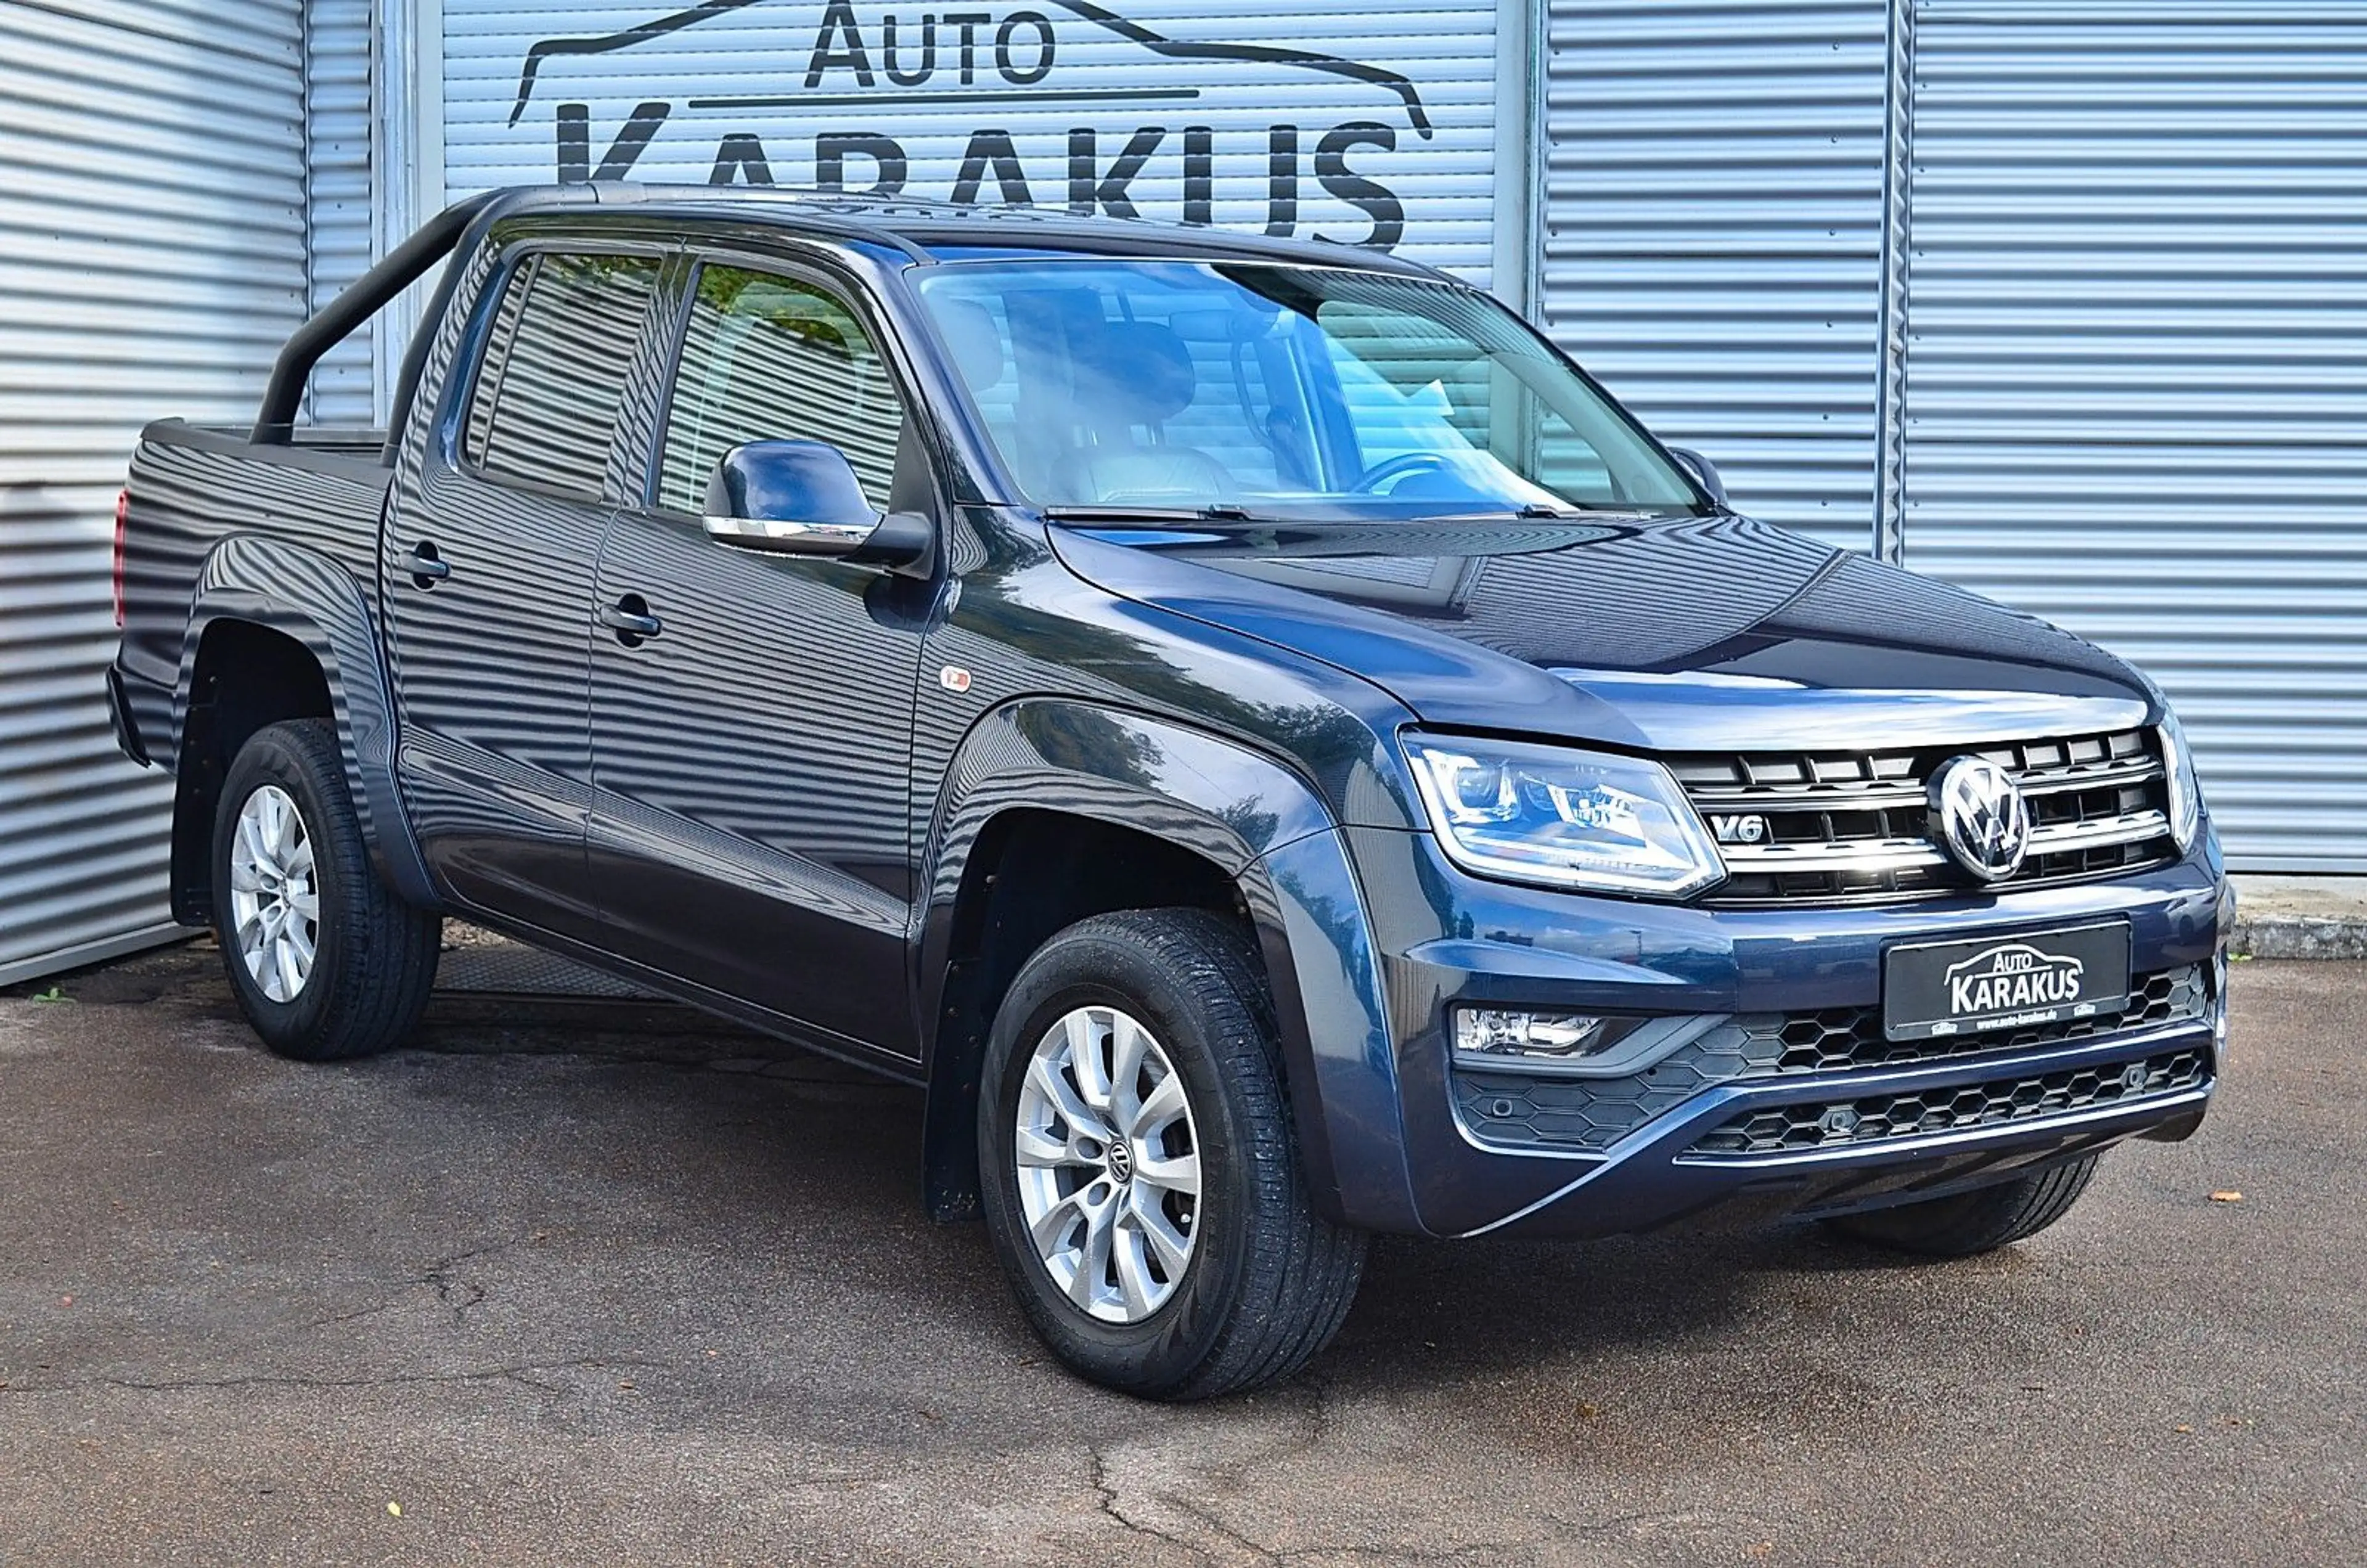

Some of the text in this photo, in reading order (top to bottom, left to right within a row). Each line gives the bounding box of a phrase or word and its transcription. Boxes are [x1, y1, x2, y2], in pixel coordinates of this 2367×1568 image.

[804, 0, 1056, 88] AUTO
[1710, 815, 1763, 843] V6
[1992, 952, 2033, 973] AUTO
